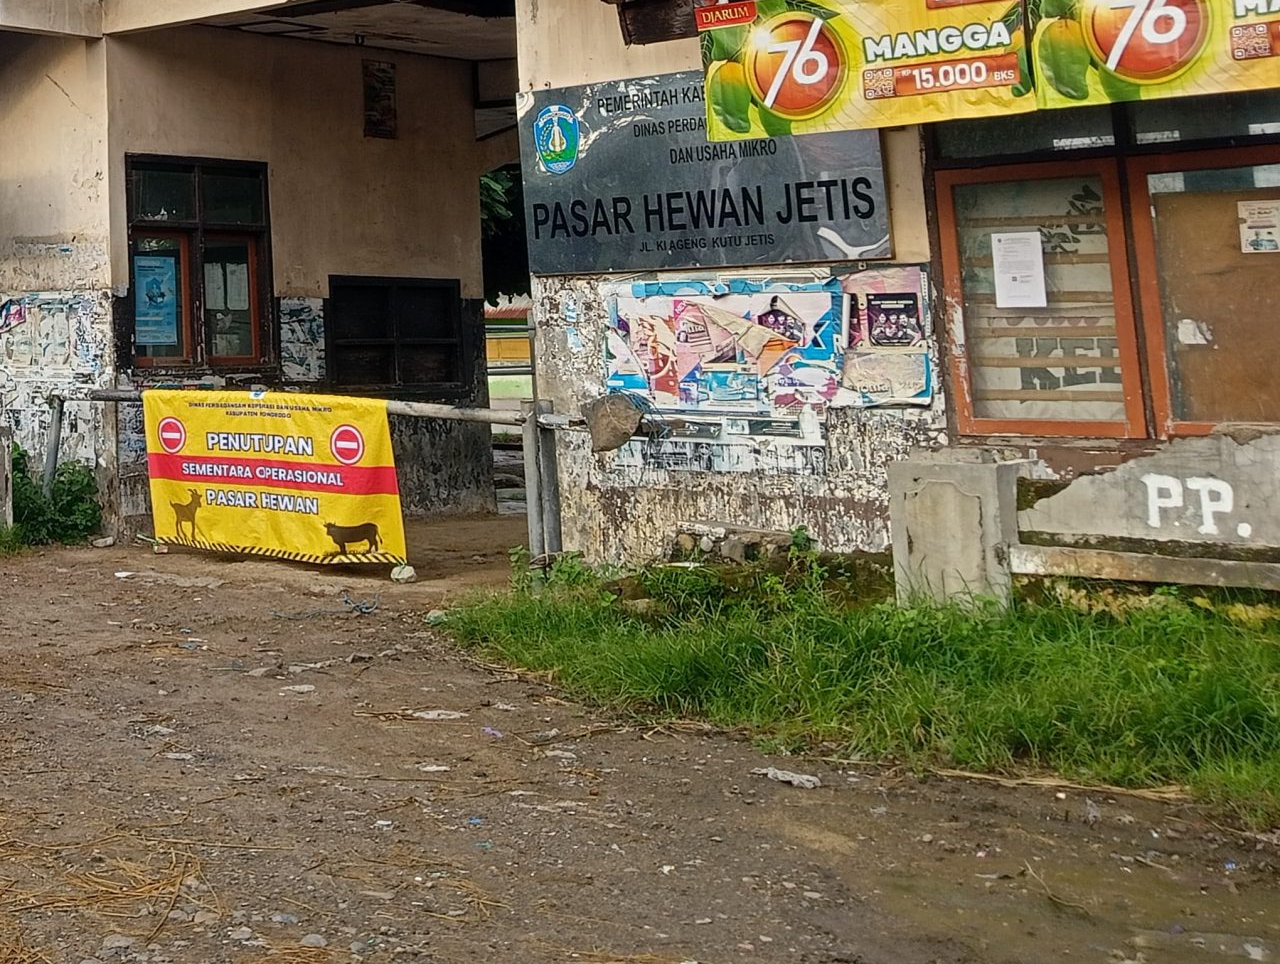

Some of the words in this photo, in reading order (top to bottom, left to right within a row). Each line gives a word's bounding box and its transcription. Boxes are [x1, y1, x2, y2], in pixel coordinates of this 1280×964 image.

[701, 4, 750, 25] DJARUM
[863, 20, 1012, 62] MANGGA
[764, 17, 829, 109] 76
[913, 62, 987, 90] 15.000
[993, 70, 1015, 82] BKS
[597, 88, 678, 114] PEMERINTAH
[633, 121, 666, 137] DINAS
[670, 147, 694, 164] DAN
[696, 142, 737, 162] USAHA
[738, 138, 777, 158] MIKRO
[533, 195, 635, 240] PASAR
[643, 185, 766, 233] HEWAN
[775, 176, 875, 225] JETIS
[656, 239, 667, 251] KI
[669, 237, 707, 251] AGENG
[712, 235, 742, 249] KUTU
[744, 233, 775, 247] JETIS
[206, 432, 313, 456] PENUTUPAN
[182, 462, 253, 479] SEMENTARA
[255, 465, 344, 486] OPERASIONAL
[206, 489, 256, 508] PASAR
[261, 491, 319, 515] HEWAN
